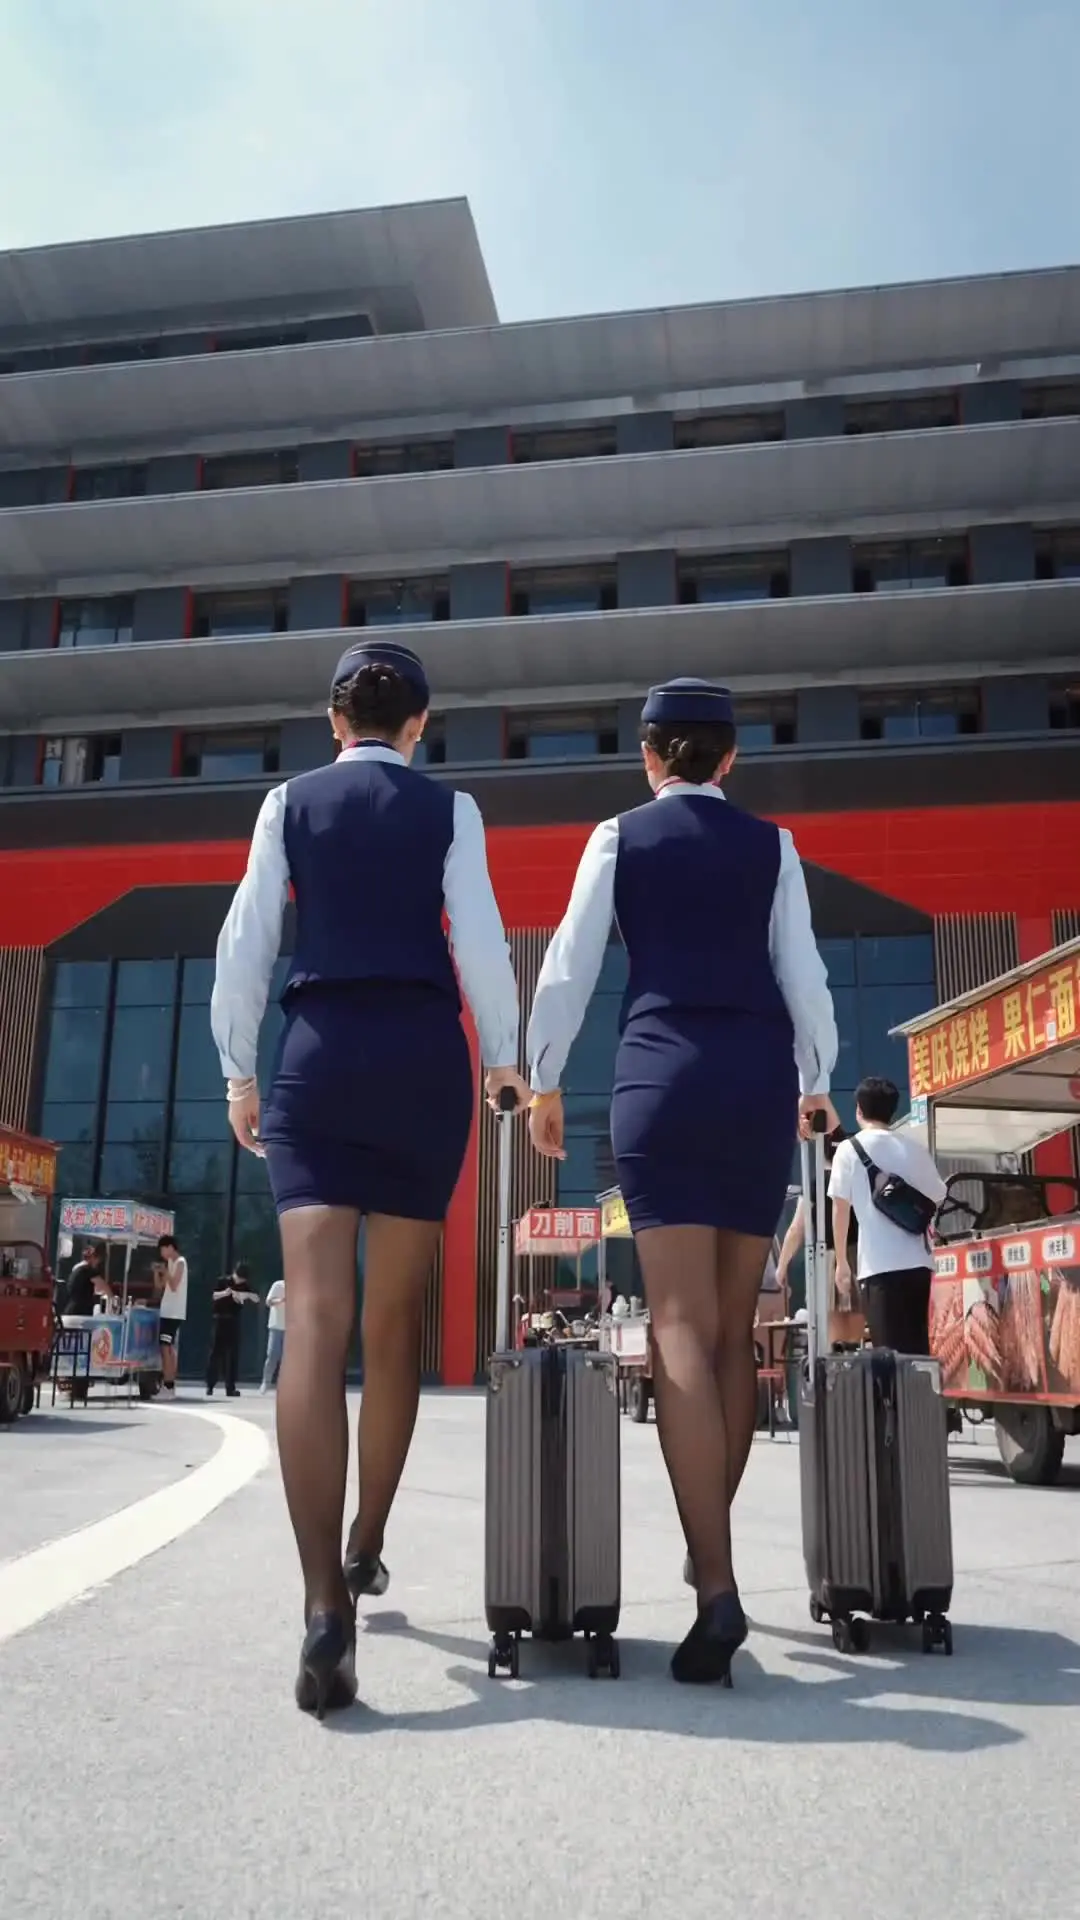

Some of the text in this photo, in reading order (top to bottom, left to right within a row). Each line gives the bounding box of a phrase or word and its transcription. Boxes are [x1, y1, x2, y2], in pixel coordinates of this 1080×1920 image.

[914, 960, 1080, 1093] 美味烧烤 果仁面
[532, 1211, 596, 1237] 刀削面
